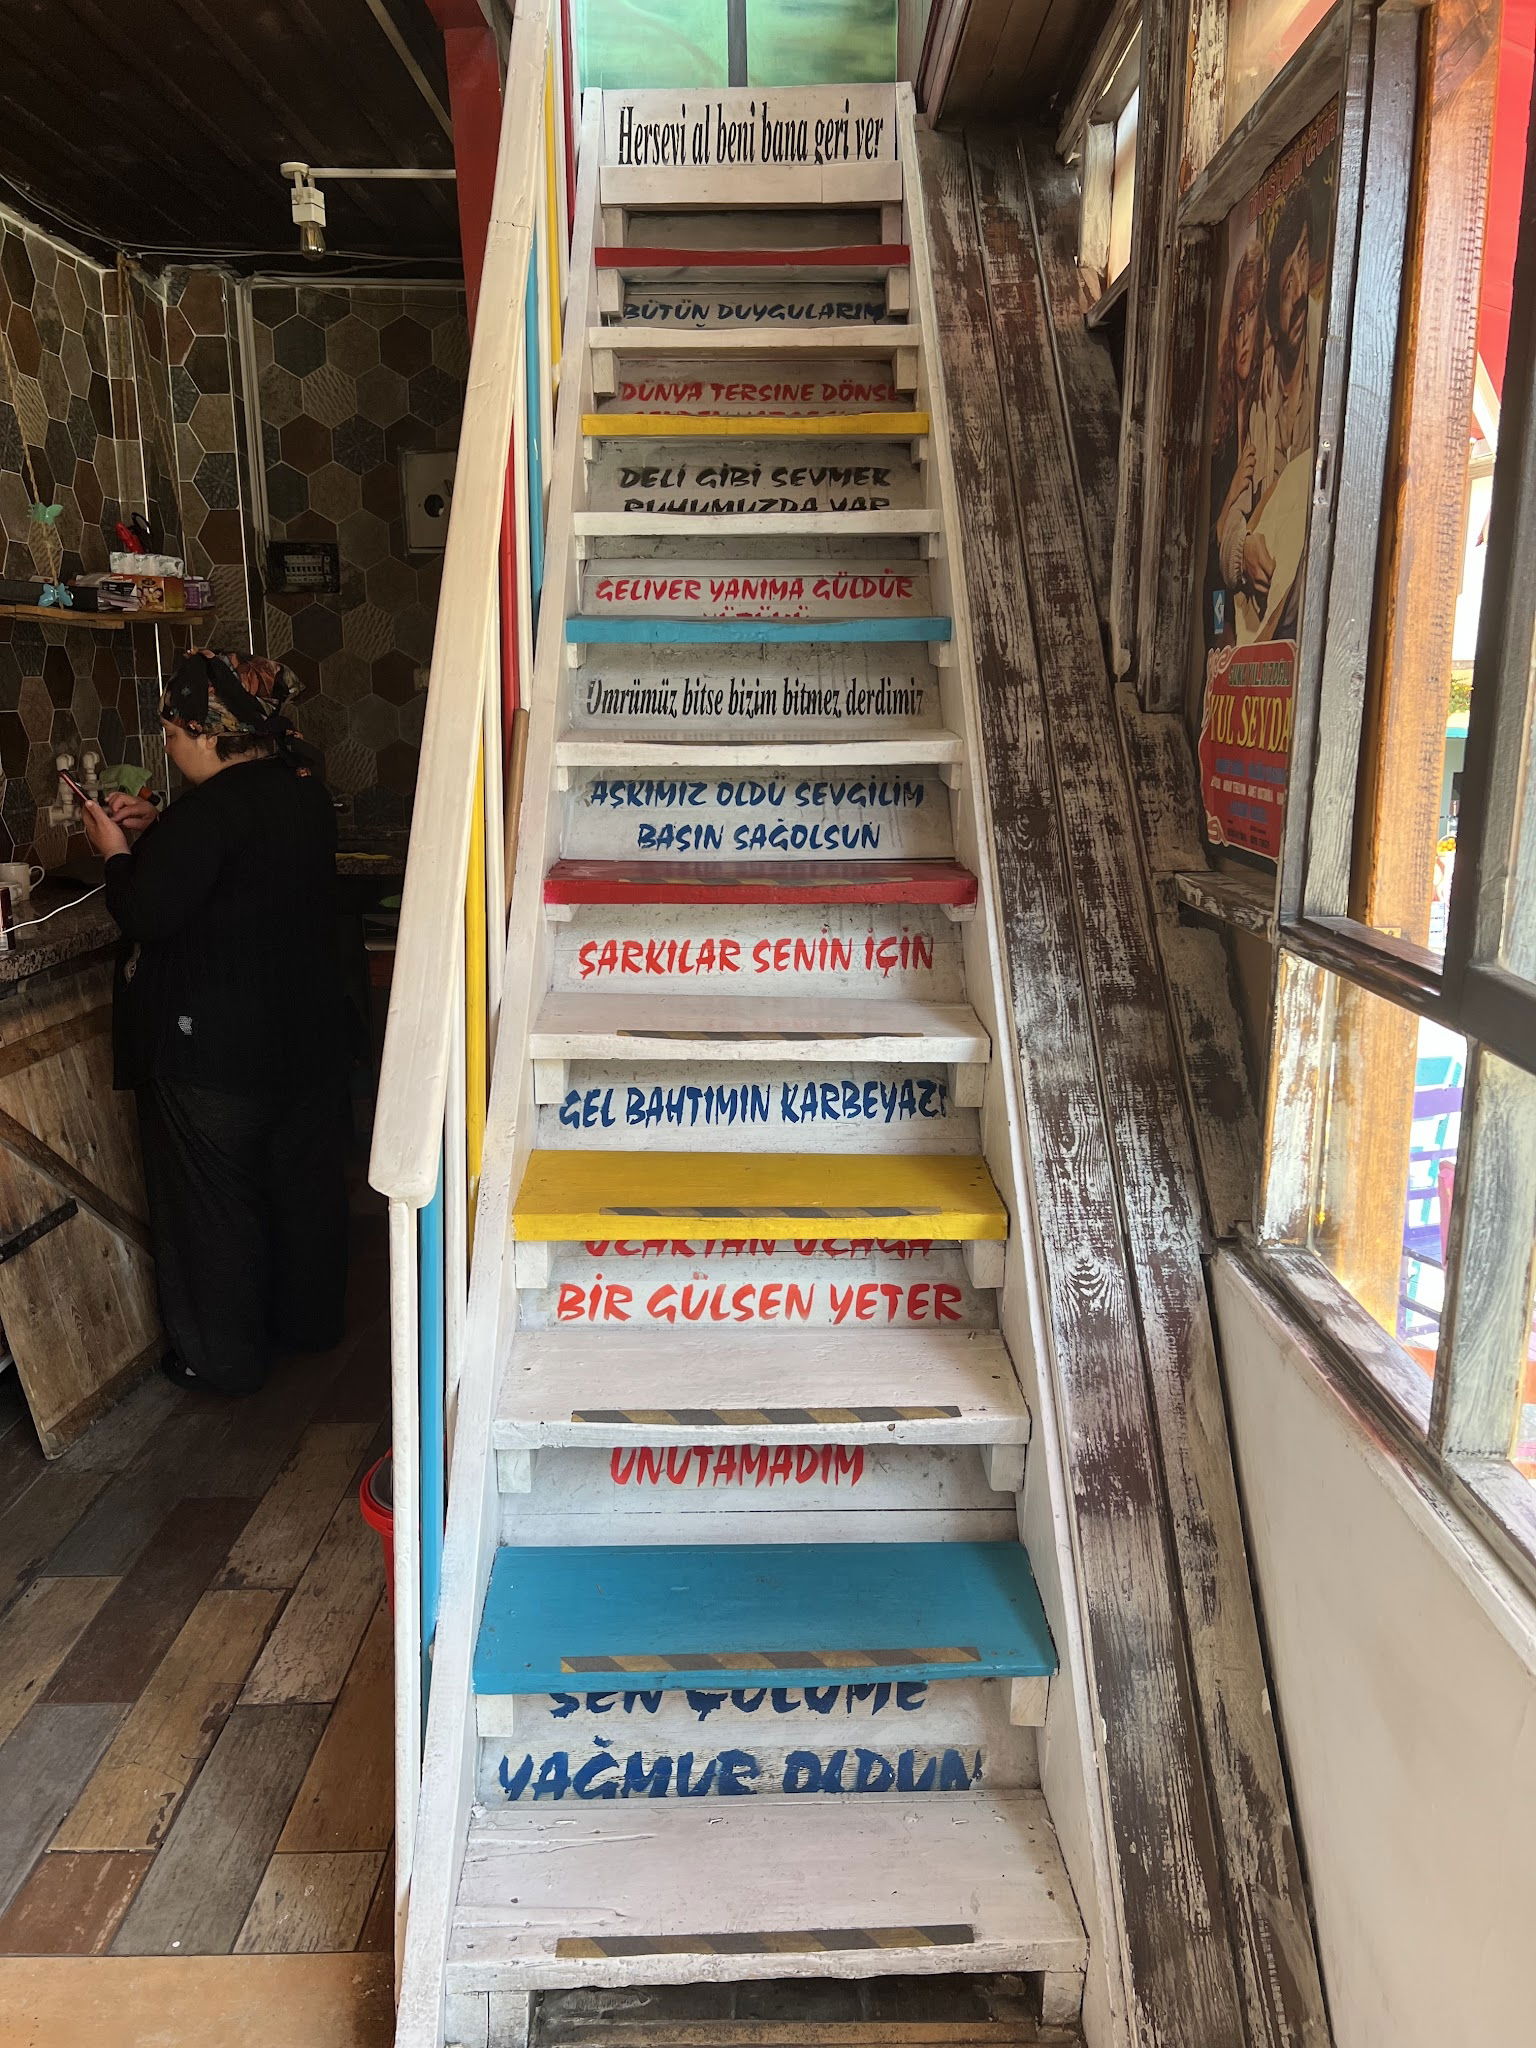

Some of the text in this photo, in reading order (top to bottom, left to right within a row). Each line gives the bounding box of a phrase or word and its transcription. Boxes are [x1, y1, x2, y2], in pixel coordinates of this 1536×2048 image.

[692, 104, 710, 165] al
[716, 101, 756, 163] beni
[762, 101, 808, 162] bana
[814, 98, 849, 164] geri
[855, 118, 884, 160] ver
[623, 299, 886, 324] BÜTÜN DUYGULARIM
[621, 380, 703, 403] DÜNYA
[711, 383, 815, 402] TERSINE
[620, 464, 687, 488] DELİ
[695, 463, 761, 488] GİBİ
[710, 578, 804, 602] YANIMA
[812, 568, 913, 601] GÜLDÜR
[682, 677, 724, 716] bitse
[728, 677, 777, 719] bizim
[782, 677, 842, 718] bitmez
[846, 677, 923, 716] derdimiz
[590, 780, 708, 808] AŞKIMIZ
[795, 775, 924, 807] SEVGİLİM
[733, 818, 881, 851] SAĞOLSUN
[578, 928, 934, 980] ŞARKILAR SENİN İÇİN
[559, 1079, 947, 1129] GEL BAHTIMIN KARBEYAZI
[557, 1271, 962, 1325] BİR GÜLSEN YETER
[610, 1444, 864, 1487] UNUTAMADIM
[499, 1735, 984, 1800] YAĞMUR OLDUN
